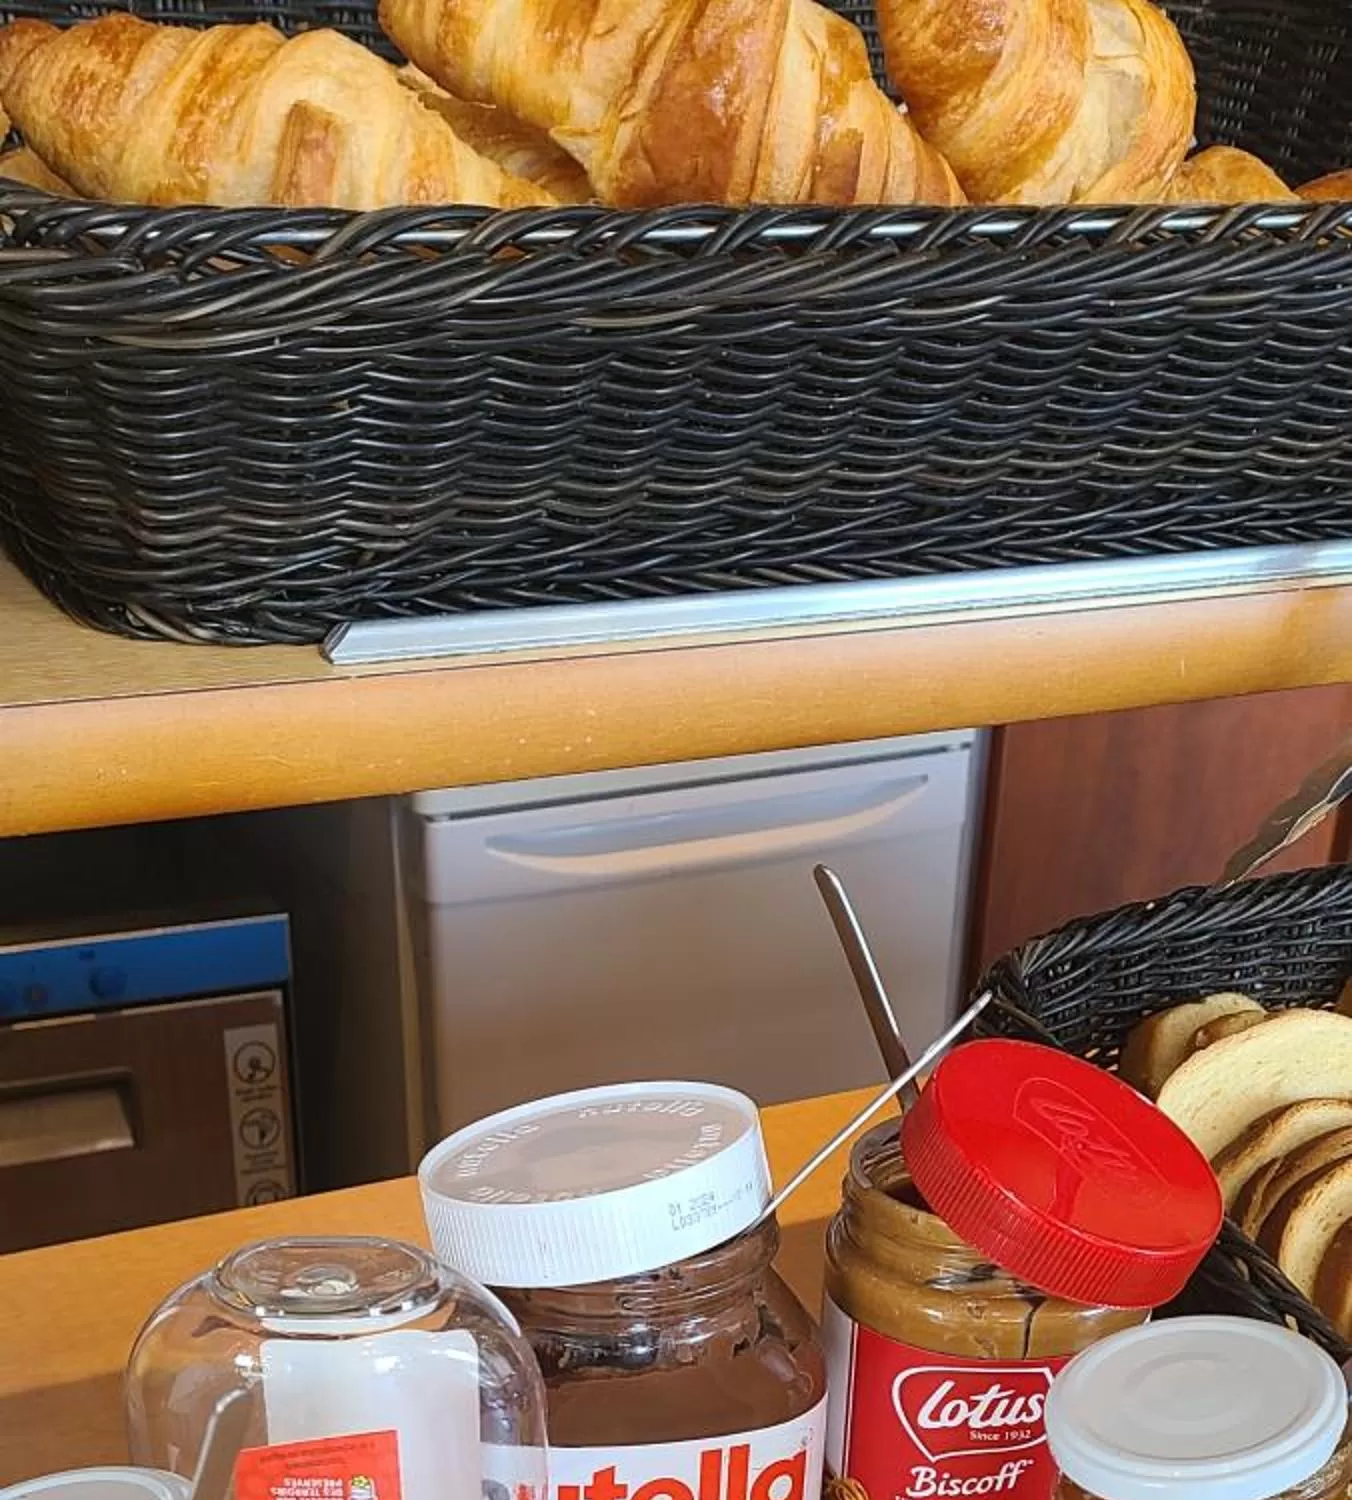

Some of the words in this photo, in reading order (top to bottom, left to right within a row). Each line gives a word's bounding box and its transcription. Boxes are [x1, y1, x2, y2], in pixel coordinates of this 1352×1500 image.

[917, 1380, 1046, 1430] Lotus
[969, 1429, 1000, 1442] Since
[905, 1460, 1028, 1498] Biscoff
